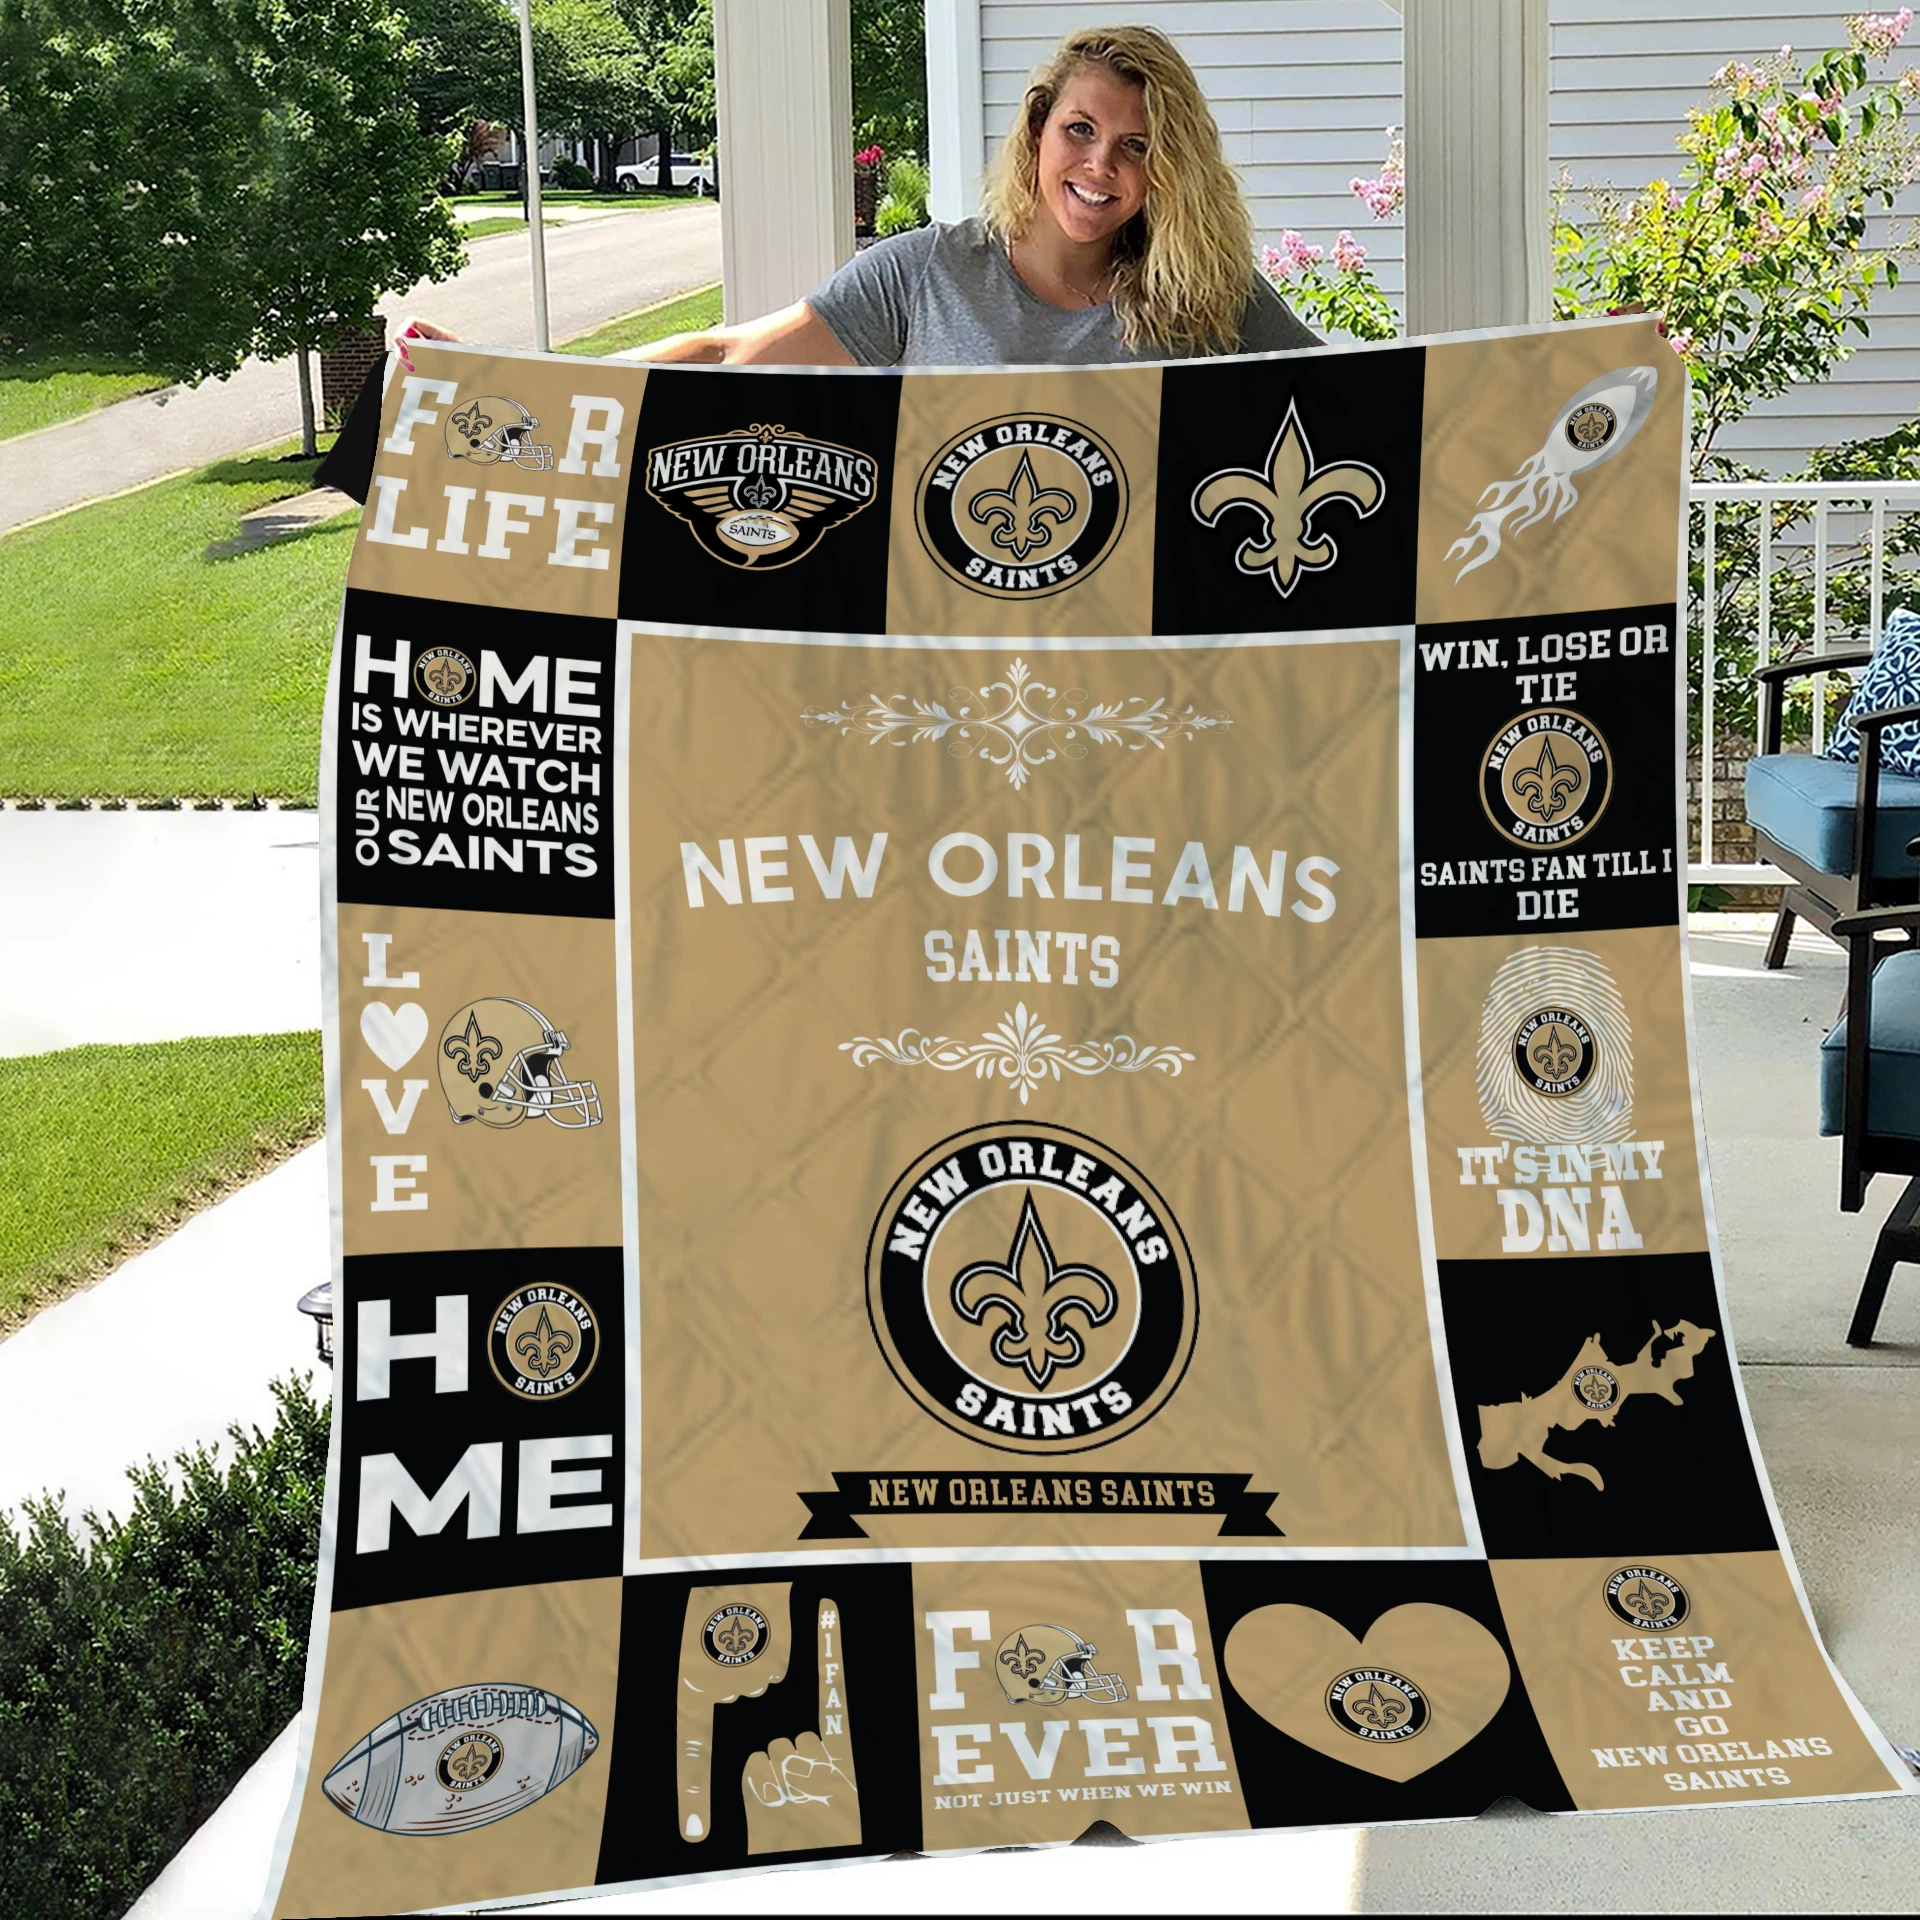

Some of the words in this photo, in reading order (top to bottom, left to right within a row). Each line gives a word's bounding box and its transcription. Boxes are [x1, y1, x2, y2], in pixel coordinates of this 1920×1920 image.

[652, 445, 727, 487] NEW
[737, 443, 872, 497] ORLEANS
[931, 433, 988, 491] NEW
[995, 423, 1114, 487] ORLEANS
[365, 475, 616, 571] LIFE
[728, 524, 777, 540] SAINTS
[965, 554, 1079, 589] SAINTS
[418, 651, 435, 670] NEW
[437, 650, 473, 675] ORLEANS
[1419, 638, 1509, 673] WIN,
[1517, 627, 1612, 663] LOSE
[1618, 623, 1670, 655] OR
[428, 691, 462, 704] SAINTS
[1515, 671, 1578, 704] TIE
[351, 702, 382, 733] IS
[392, 706, 603, 755] WHEREVER
[1488, 724, 1523, 771] NEW
[1526, 715, 1604, 763] ORLEANS
[351, 740, 425, 781] WE
[437, 748, 601, 797] WATCH
[355, 788, 381, 866] OUR
[386, 785, 455, 823] NEW
[462, 792, 599, 836] ORLEANS
[1512, 815, 1584, 843] SAINTS
[387, 829, 598, 878] SAINTS
[1420, 858, 1525, 886] SAINTS
[1531, 854, 1589, 883] FAN
[1592, 850, 1657, 878] TILL
[1662, 848, 1673, 874] I
[680, 832, 888, 909] NEW
[927, 831, 1341, 923] ORLEANS
[1516, 888, 1580, 922] DIE
[924, 929, 1121, 989] SAINTS
[1518, 1018, 1538, 1047] NEW
[1540, 1012, 1590, 1044] ORLEANS
[1535, 1076, 1580, 1092] SAINTS
[1457, 1141, 1539, 1185] IT'S
[1545, 1144, 1592, 1183] IN
[1601, 1140, 1665, 1181] MY
[888, 1159, 969, 1262] NEW
[978, 1140, 1170, 1265] ORLEANS
[1496, 1185, 1644, 1253] DNA
[495, 1296, 524, 1334] NEW
[527, 1288, 592, 1330] ORLEANS
[515, 1372, 575, 1394] SAINTS
[955, 1381, 1133, 1436] SAINTS
[869, 1479, 939, 1507] NEW
[949, 1479, 1093, 1507] ORLEANS
[1101, 1480, 1216, 1507] SAINTS
[1608, 1574, 1626, 1595] NEW
[1625, 1569, 1680, 1593] ORLEANS
[707, 1611, 725, 1632] NEW
[726, 1607, 765, 1629] ORLEANS
[1633, 1616, 1678, 1628] SAINTS
[718, 1651, 755, 1664] SAINTS
[1611, 1635, 1715, 1661] KEEP
[1331, 1676, 1354, 1701] NEW
[1354, 1671, 1419, 1699] ORLEANS
[1620, 1662, 1734, 1688] CALM
[1647, 1688, 1732, 1712] AND
[1358, 1725, 1414, 1739] SAINTS
[1674, 1716, 1729, 1737] GO
[443, 1740, 461, 1761] NEW
[463, 1734, 500, 1753] ORLEANS
[931, 1716, 1228, 1786] EVER
[1591, 1744, 1669, 1768] NEW
[1678, 1736, 1833, 1765] ORELANS
[449, 1775, 486, 1789] SAINTS
[934, 1793, 983, 1811] NOT
[989, 1789, 1050, 1808] JUST
[1056, 1785, 1131, 1803] WHEN
[1135, 1783, 1183, 1799] WE
[1186, 1780, 1232, 1797] WIN
[1663, 1767, 1791, 1792] SAINTS
